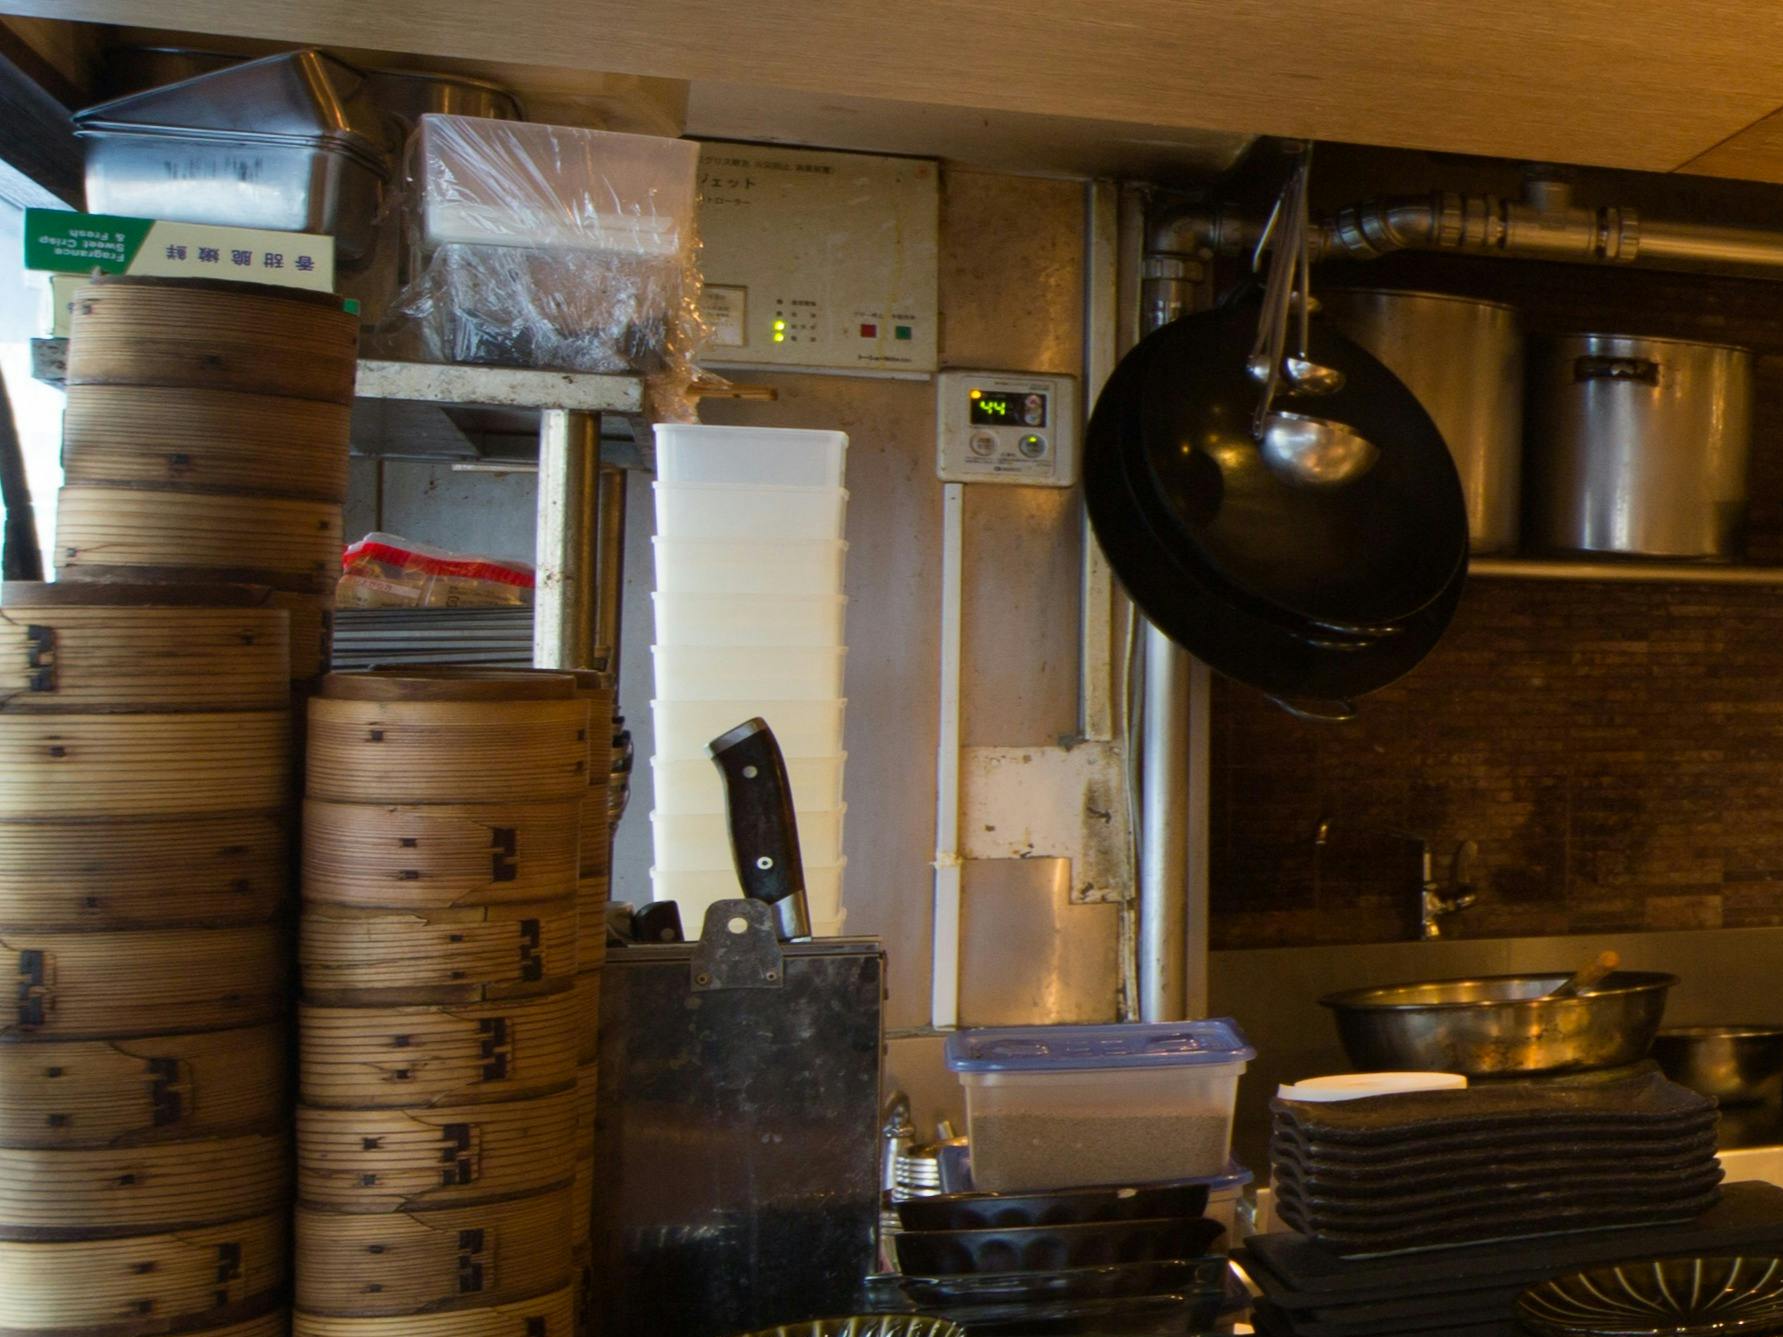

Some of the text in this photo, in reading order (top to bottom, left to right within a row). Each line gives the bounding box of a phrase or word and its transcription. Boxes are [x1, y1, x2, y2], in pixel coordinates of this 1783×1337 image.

[68, 229, 109, 241] Fresh
[38, 235, 125, 252] Sweet Crisp
[54, 247, 125, 262] Fragrance
[980, 400, 1006, 415] 44
